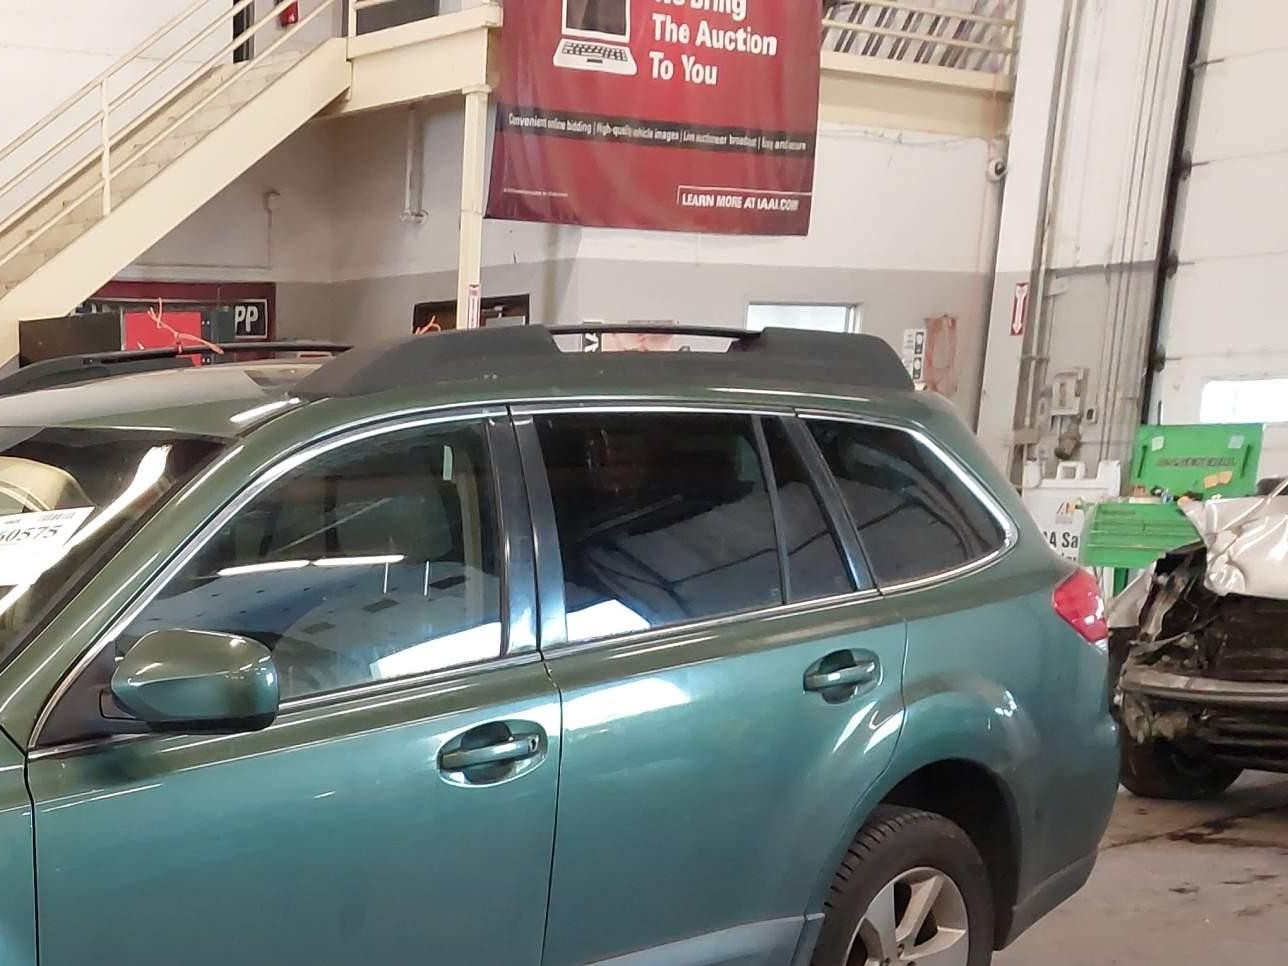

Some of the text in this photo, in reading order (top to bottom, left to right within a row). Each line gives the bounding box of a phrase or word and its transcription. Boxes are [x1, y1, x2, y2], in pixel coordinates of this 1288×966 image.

[652, 12, 777, 56] The Auction
[648, 50, 718, 85] To You
[508, 113, 547, 128] Convenient
[566, 118, 592, 135] bidding
[654, 128, 679, 142] images
[682, 192, 715, 207] LEARN
[715, 195, 743, 208] MORE
[743, 197, 757, 209] AT
